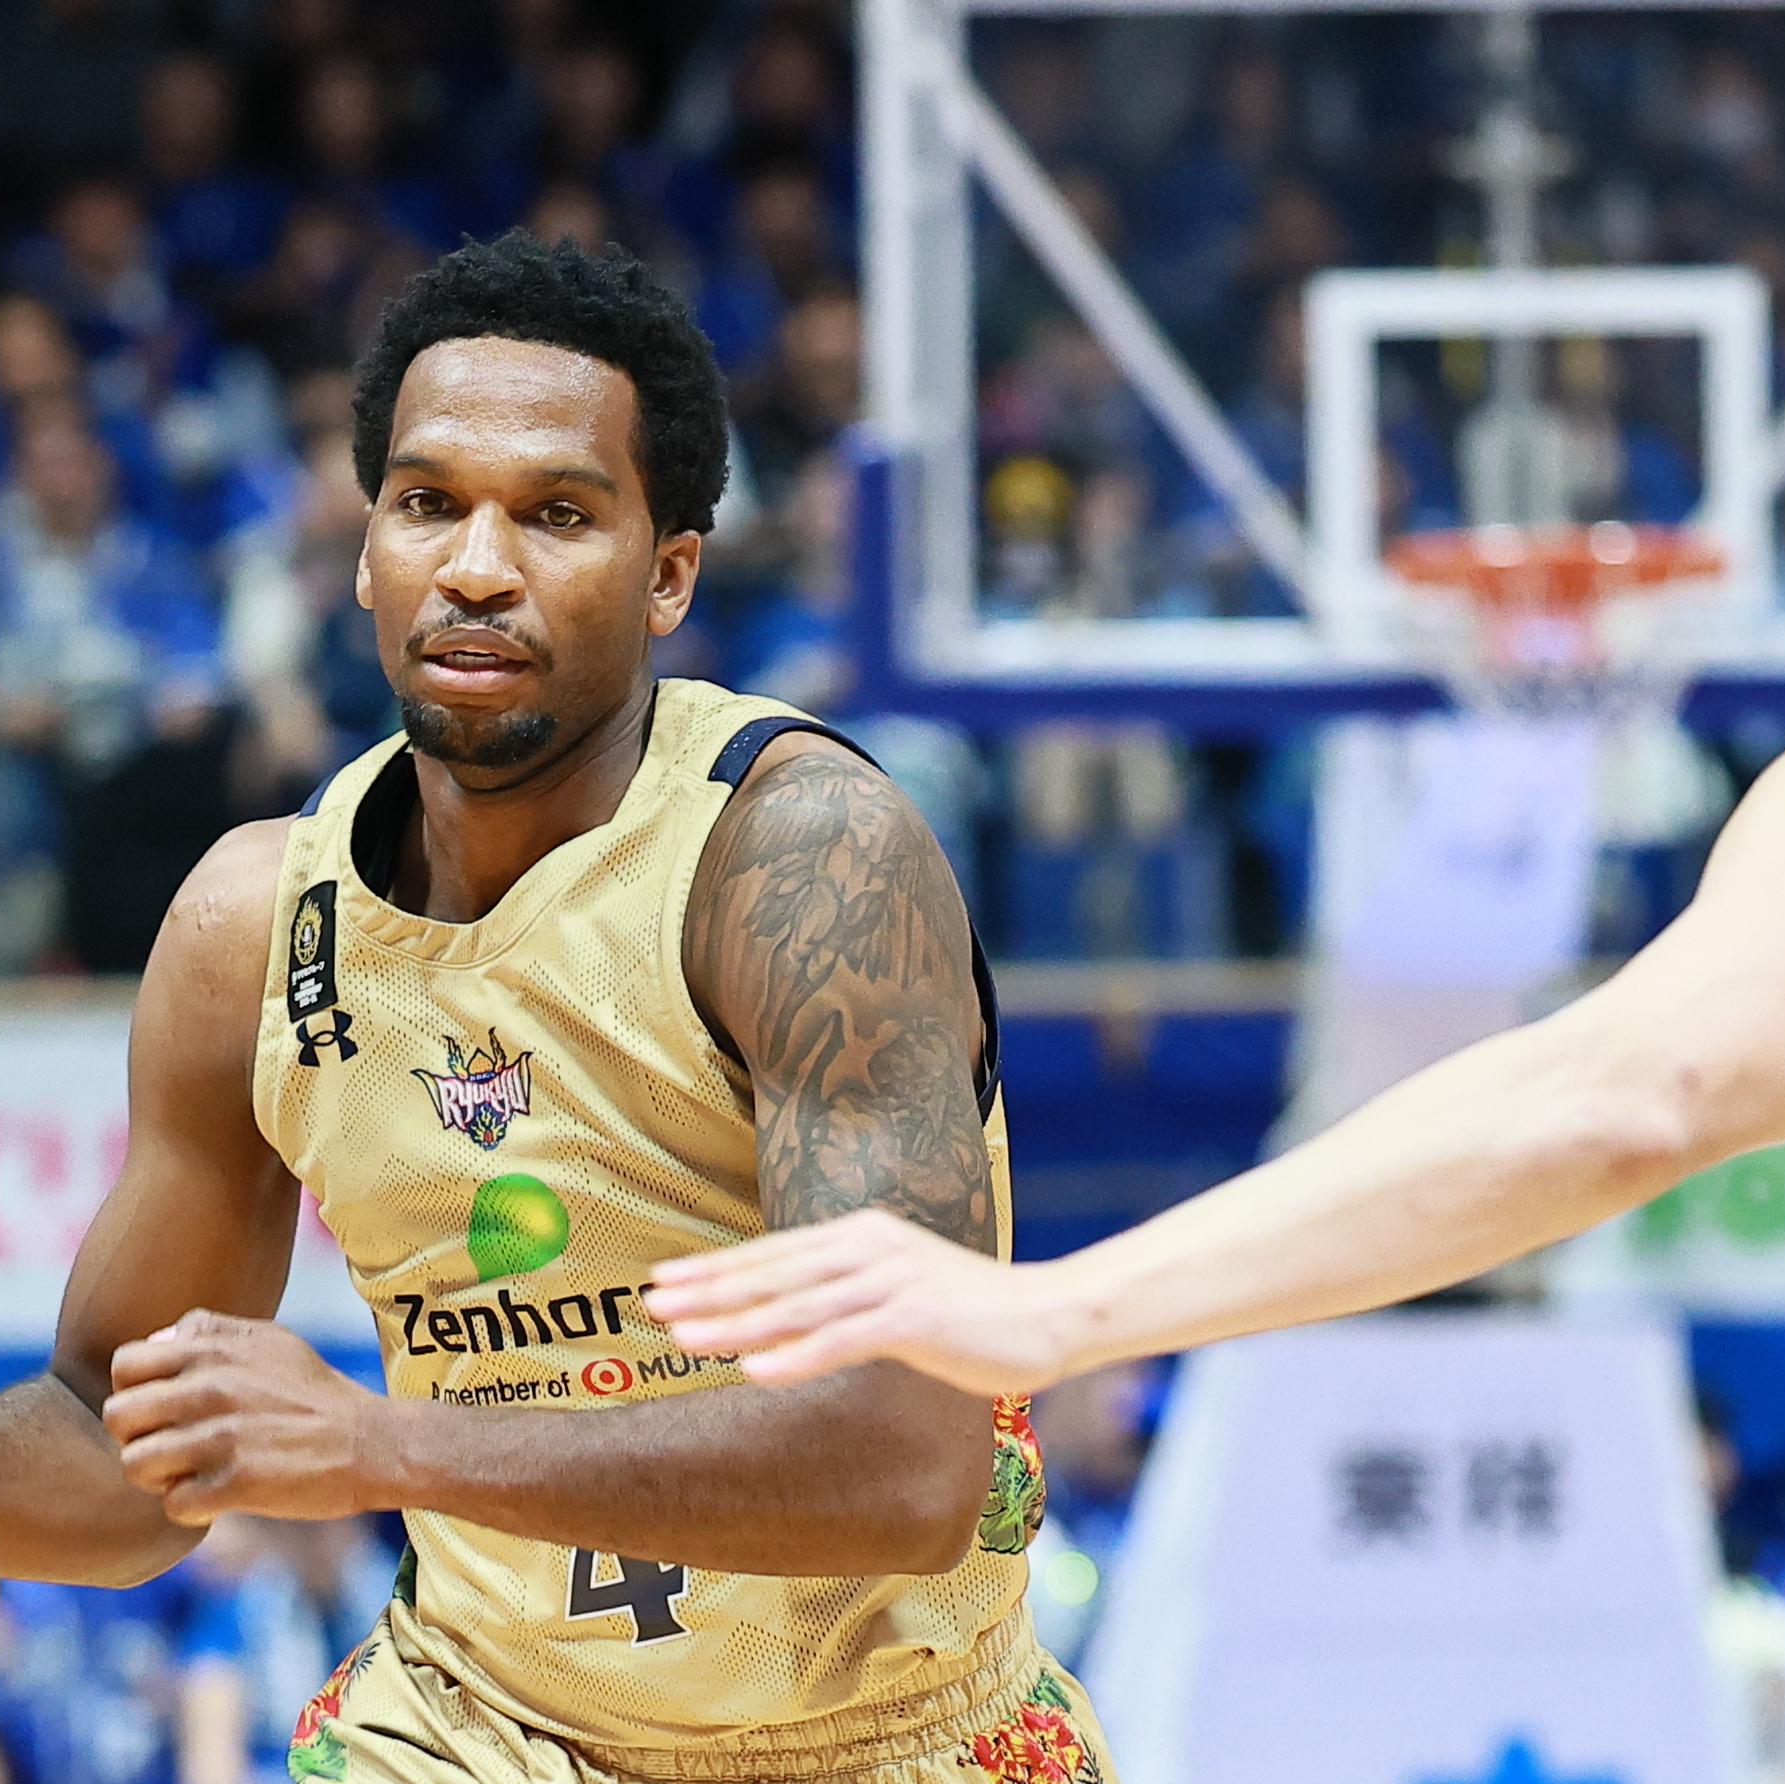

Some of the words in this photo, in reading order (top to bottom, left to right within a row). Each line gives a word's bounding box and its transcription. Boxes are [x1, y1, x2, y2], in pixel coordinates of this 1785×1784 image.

[435, 1062, 530, 1131] RYUKYU
[394, 1282, 654, 1356] Zenhor
[443, 1377, 539, 1404] member
[548, 1372, 571, 1397] of
[564, 1548, 692, 1648] 4
